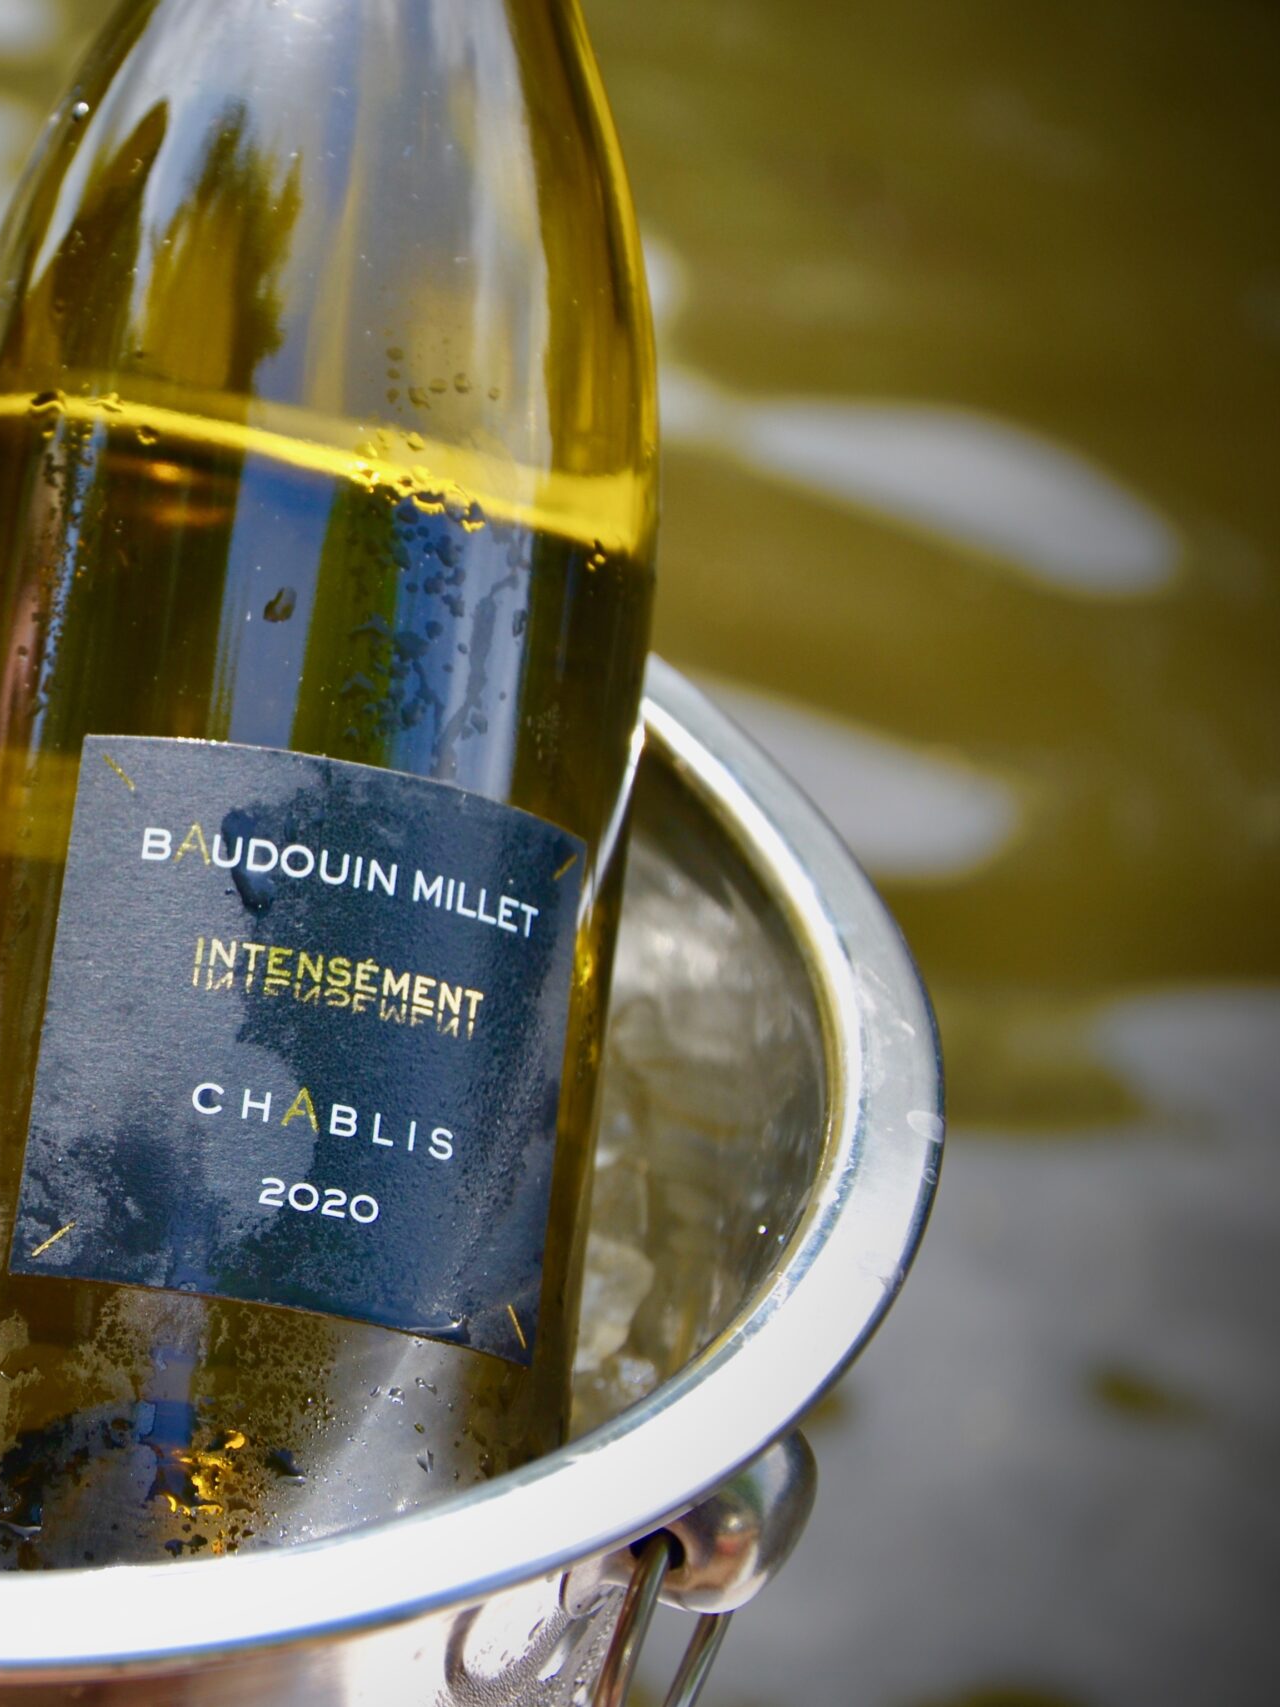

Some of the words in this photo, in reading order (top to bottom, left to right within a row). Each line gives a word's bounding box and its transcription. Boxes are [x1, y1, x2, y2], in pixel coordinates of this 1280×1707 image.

[140, 821, 398, 896] BAUDOUIN
[412, 869, 540, 938] MILLET
[192, 936, 484, 1018] INTENSÉMENT
[192, 1082, 455, 1161] CHABLIS
[258, 1177, 380, 1225] 2020
